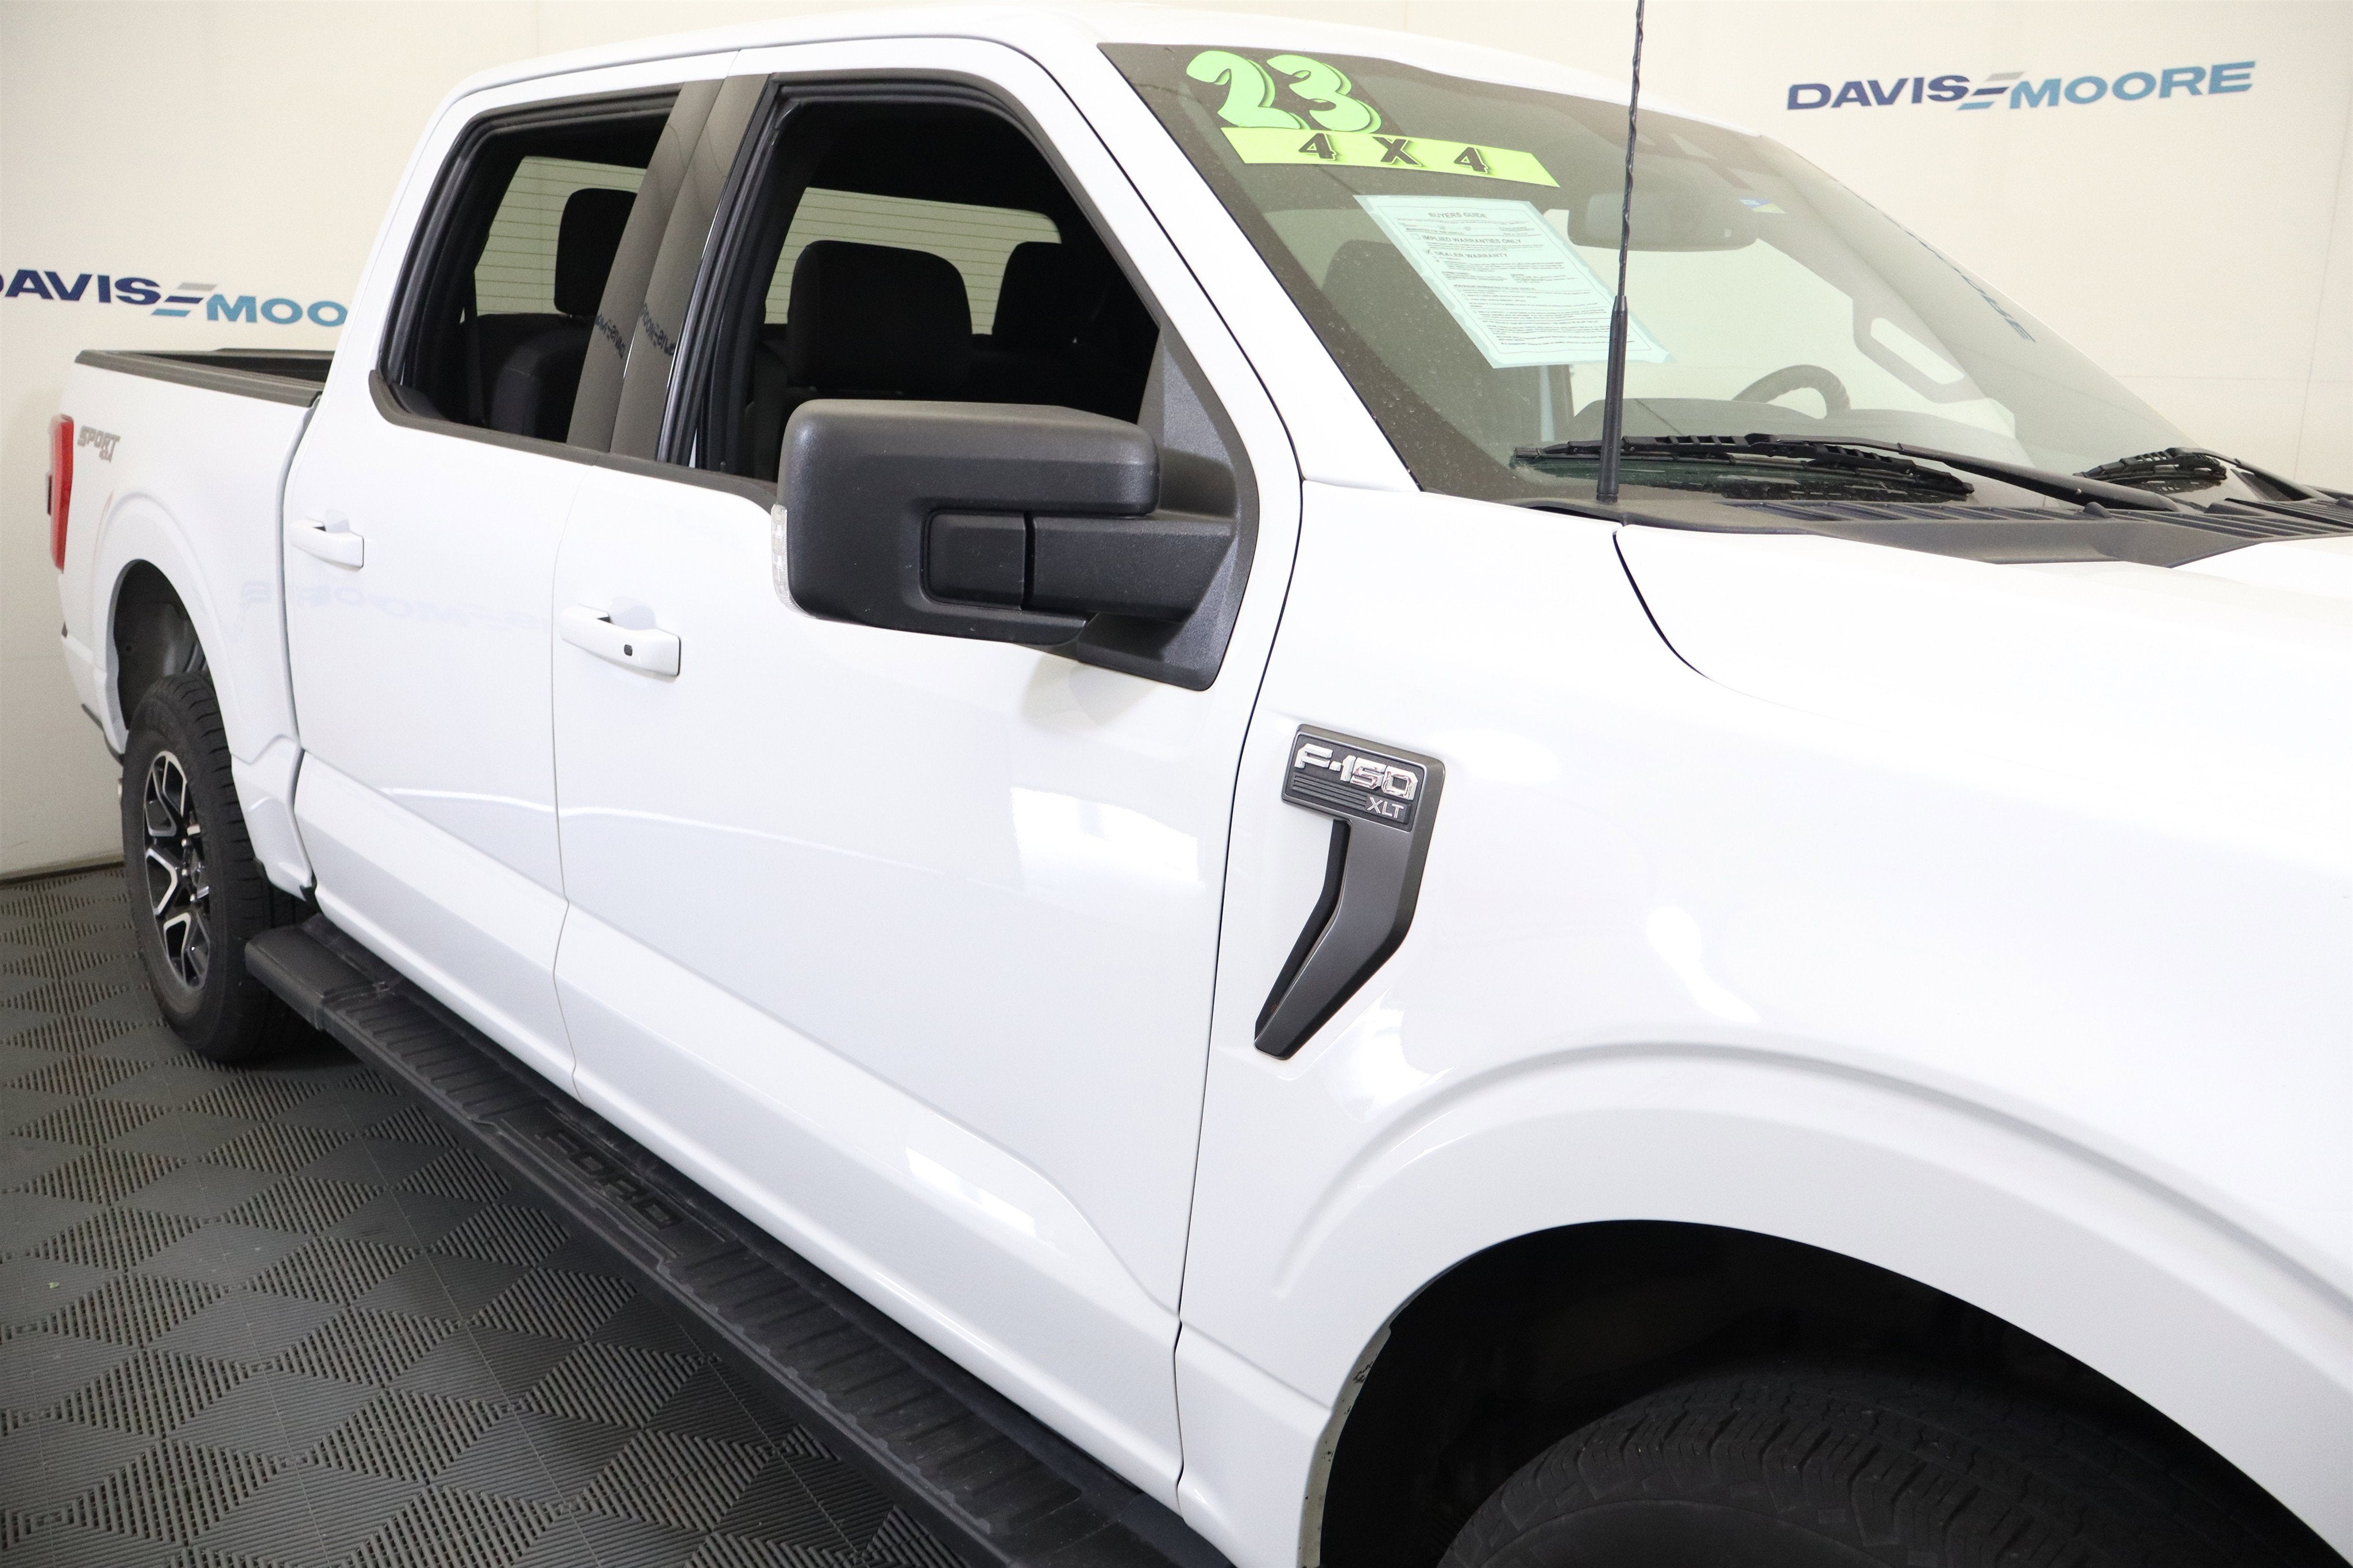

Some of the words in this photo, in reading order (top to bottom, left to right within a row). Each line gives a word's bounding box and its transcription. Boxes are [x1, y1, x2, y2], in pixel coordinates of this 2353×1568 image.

[1186, 50, 1381, 133] 23
[1787, 74, 1970, 111] DAVIS
[2009, 60, 2256, 110] MOORE
[0, 268, 161, 306] AVIS
[1294, 743, 1419, 801] F-150
[1367, 796, 1405, 819] XLT
